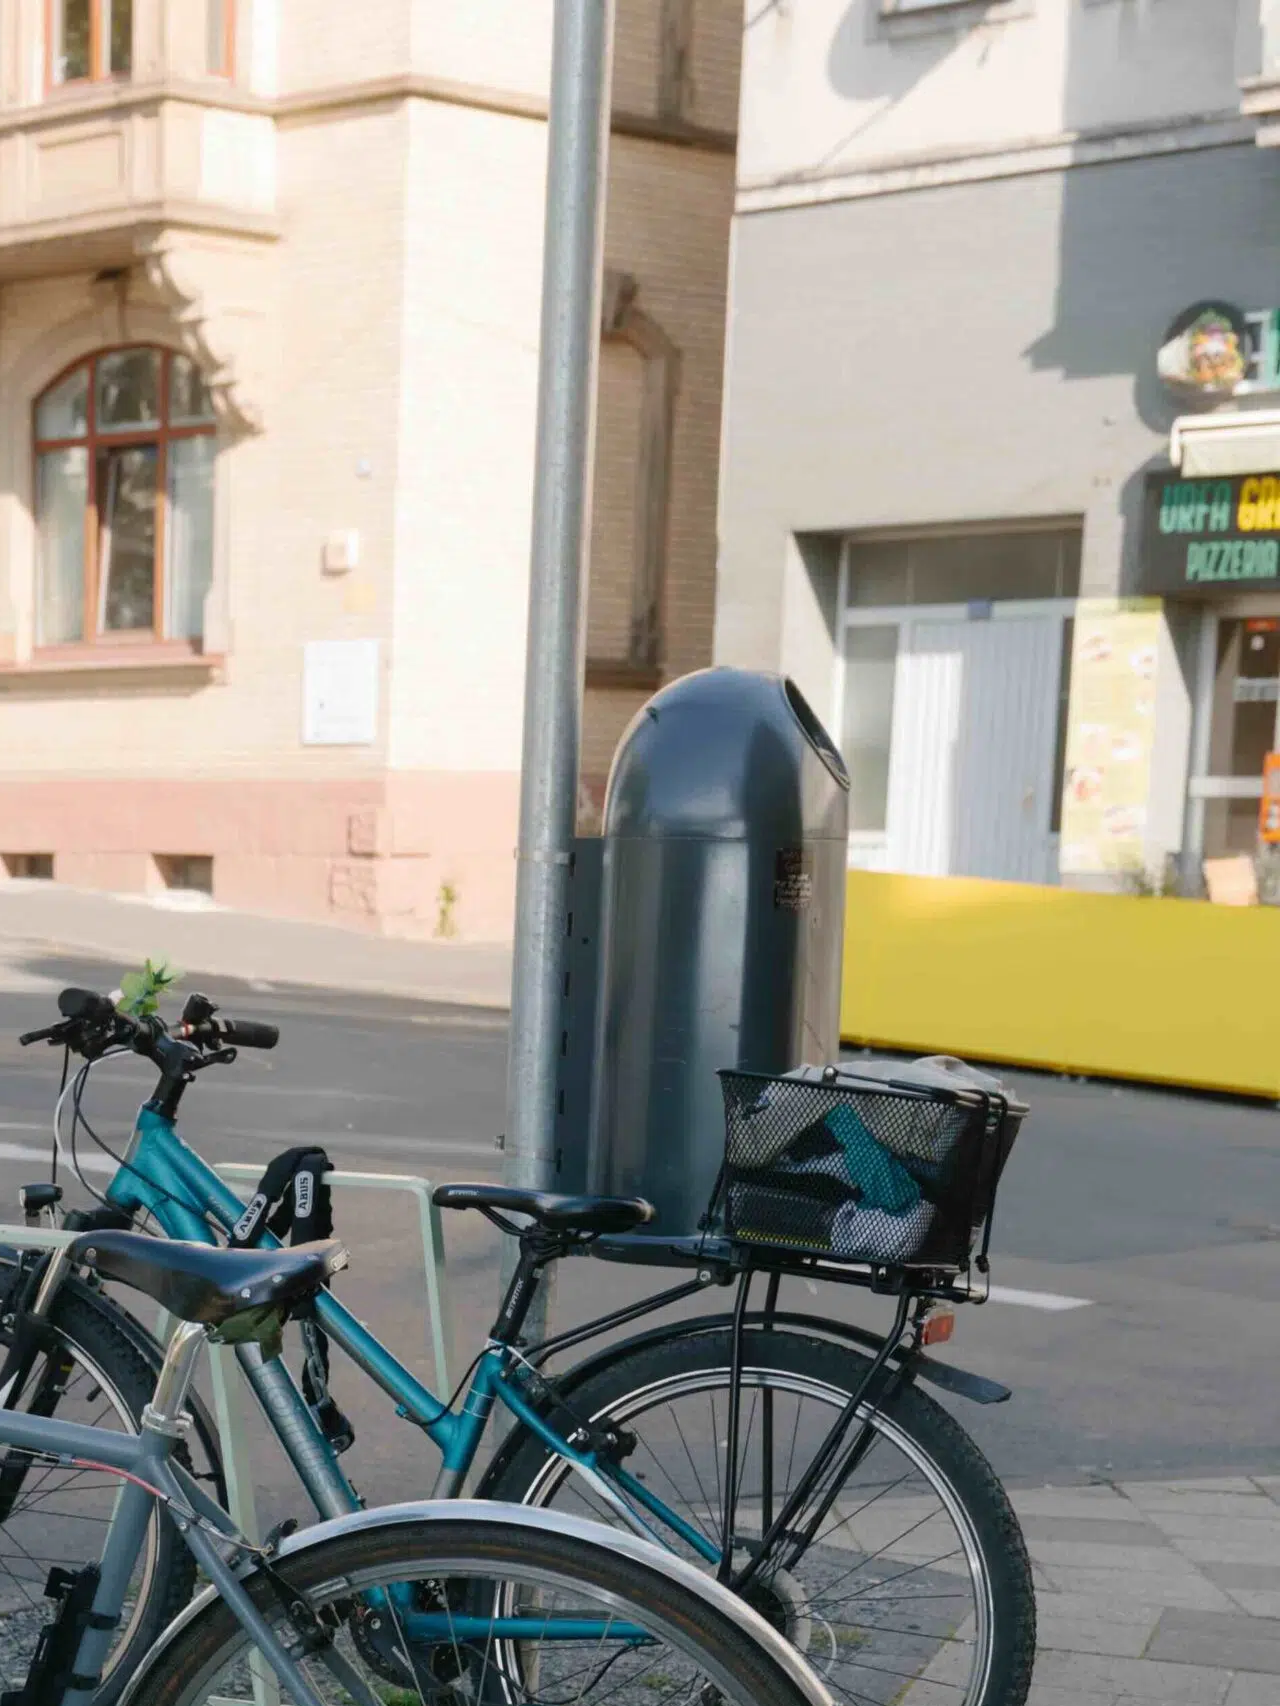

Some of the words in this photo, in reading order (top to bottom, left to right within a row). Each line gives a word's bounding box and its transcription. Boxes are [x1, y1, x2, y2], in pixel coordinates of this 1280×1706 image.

[1186, 540, 1278, 582] PIZZERIA
[297, 1176, 309, 1210] ABUS
[239, 1198, 263, 1234] ABUS
